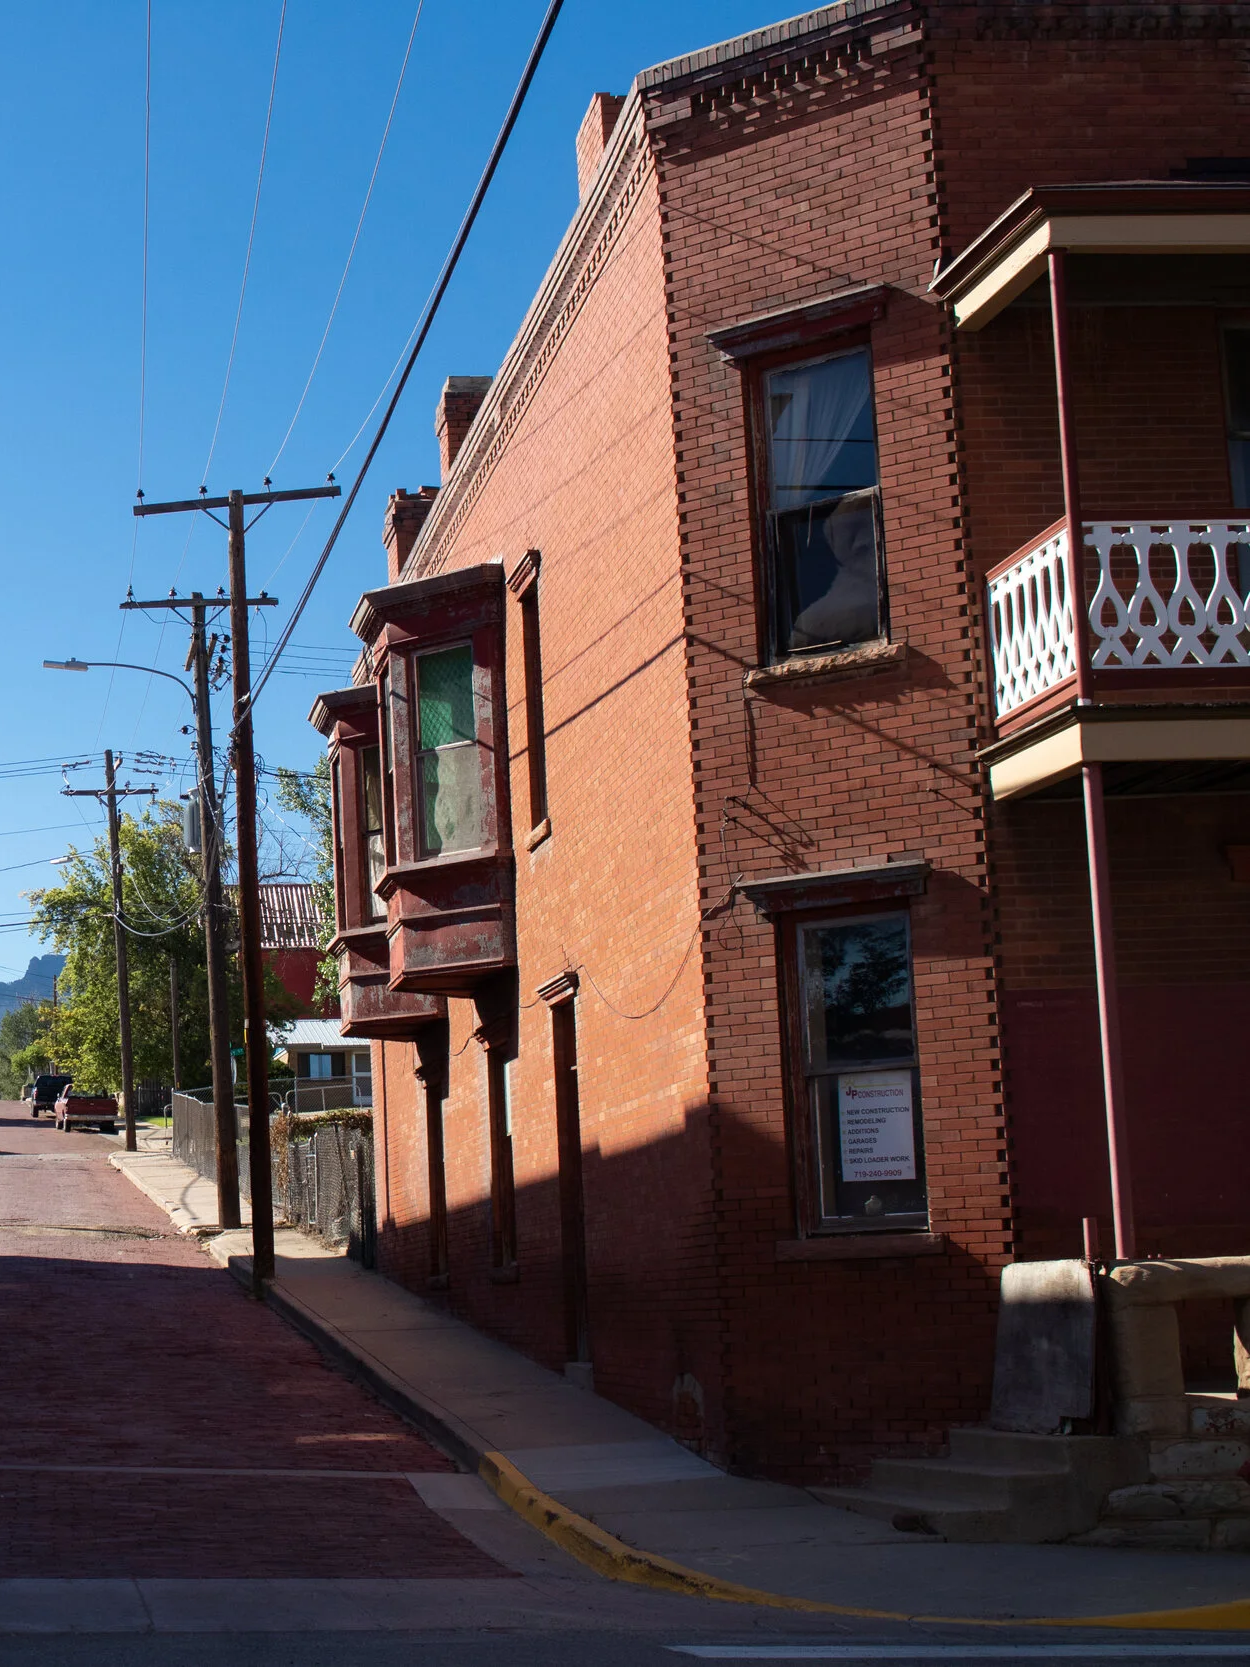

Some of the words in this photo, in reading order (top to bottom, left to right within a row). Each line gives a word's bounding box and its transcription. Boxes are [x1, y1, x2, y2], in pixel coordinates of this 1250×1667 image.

[846, 1086, 858, 1100] JP
[858, 1088, 904, 1099] CONSTRUCTION
[861, 1106, 910, 1115] CONSTRUCTION
[847, 1117, 886, 1126] REMODELING
[848, 1127, 879, 1135] ADDITIONS
[848, 1137, 877, 1145] GARAGES
[849, 1147, 874, 1155] REPAIRS
[854, 1169, 902, 1178] 719-240-9909
